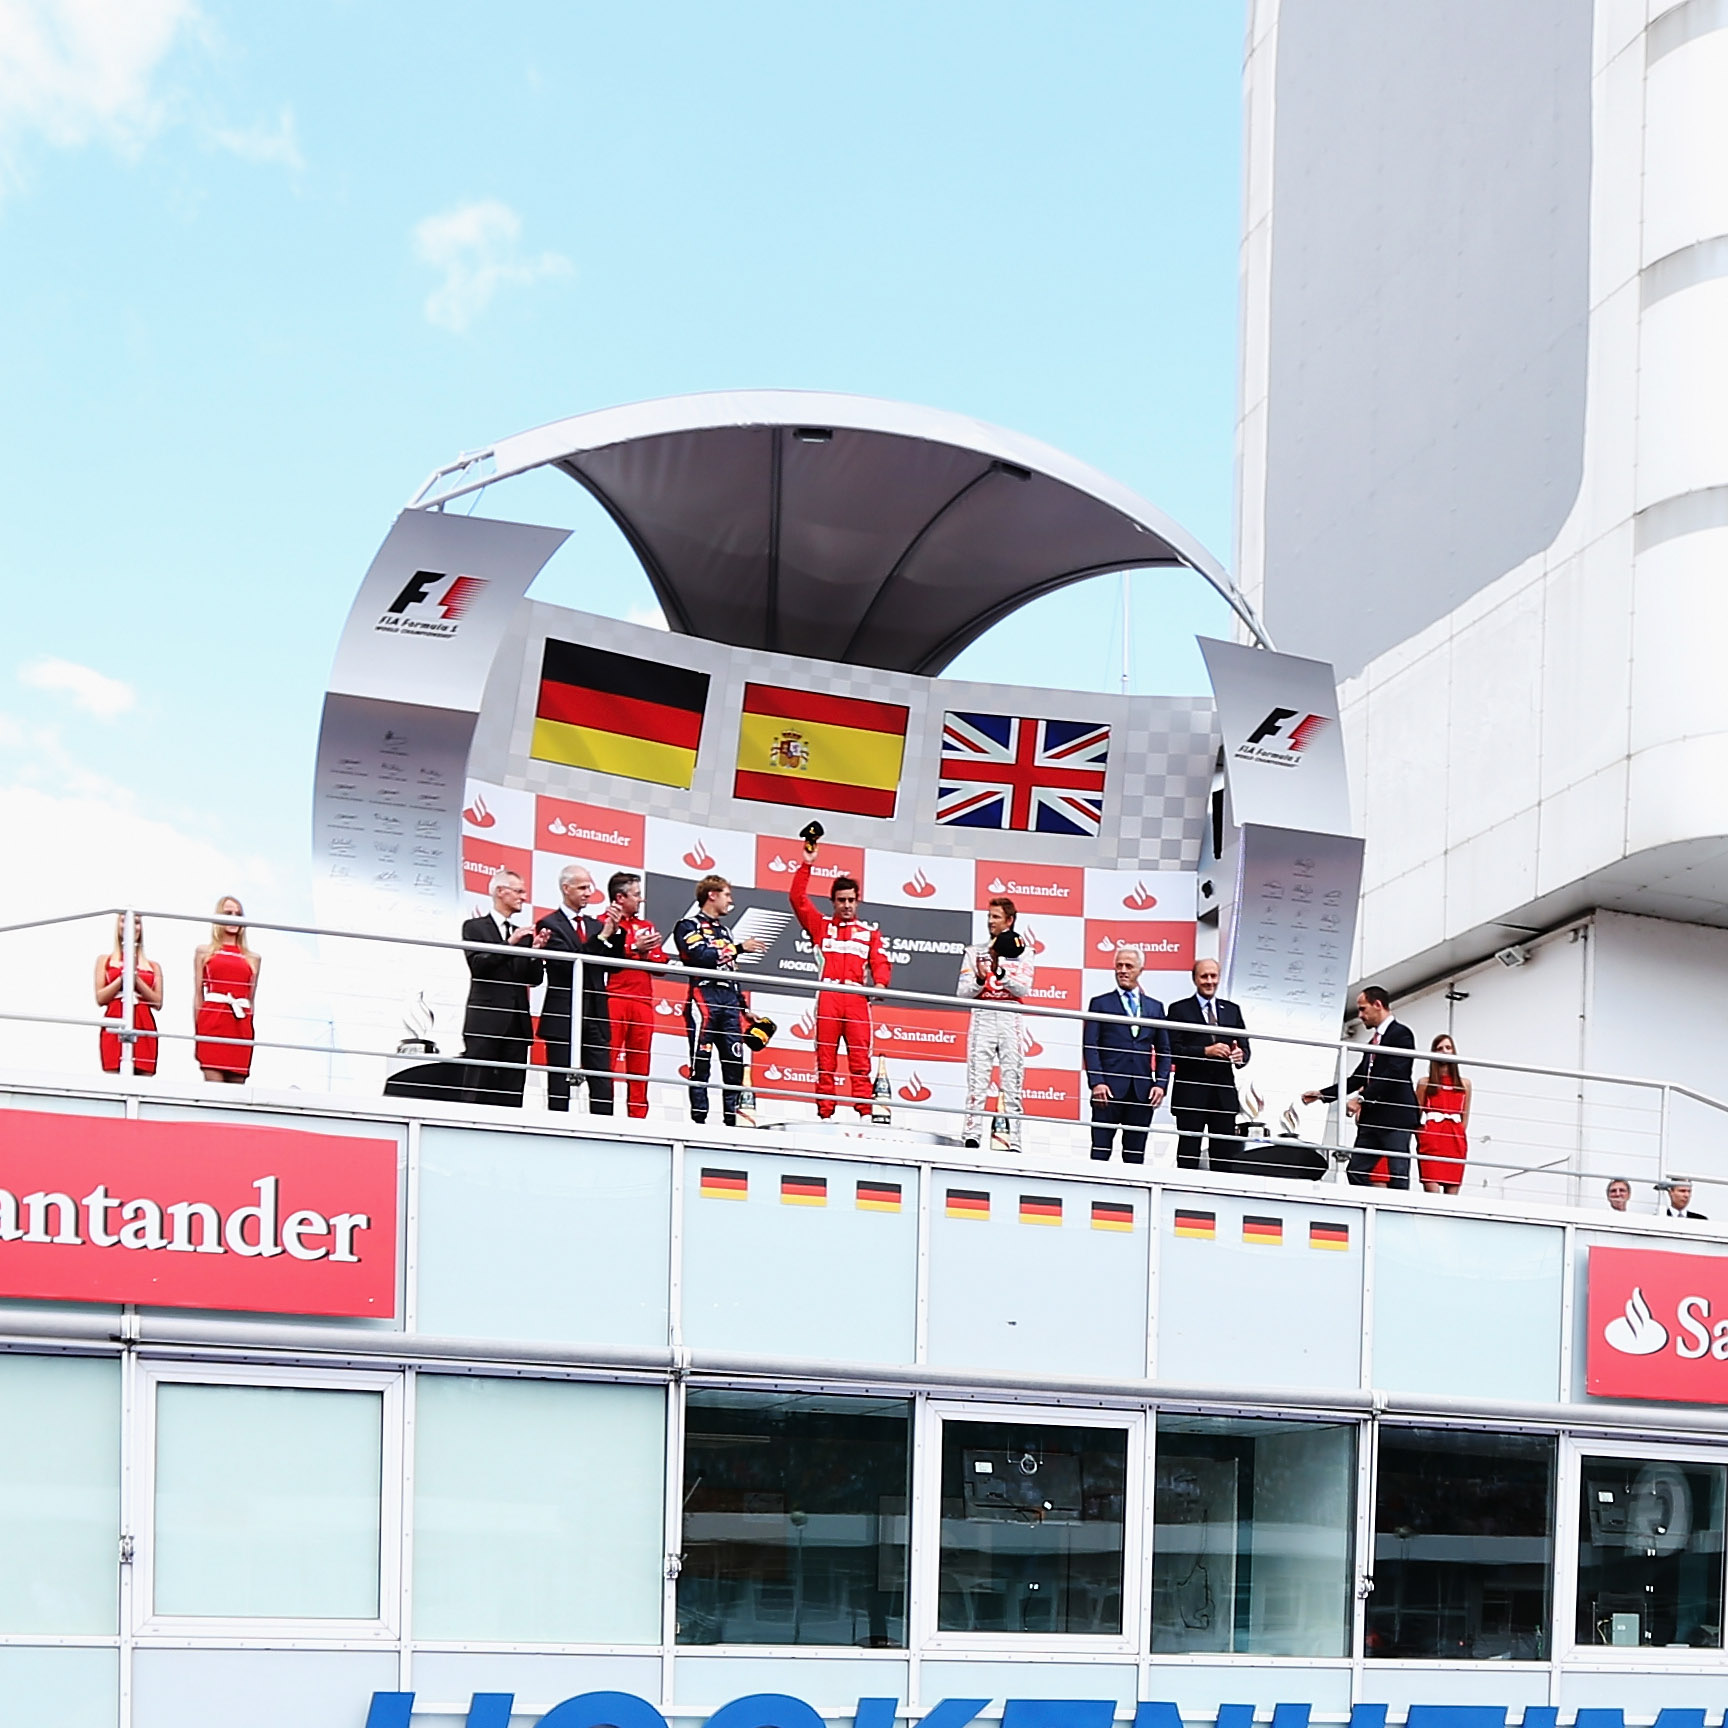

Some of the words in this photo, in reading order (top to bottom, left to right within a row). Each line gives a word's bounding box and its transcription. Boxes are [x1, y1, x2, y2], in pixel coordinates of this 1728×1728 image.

[387, 569, 491, 620] F1
[1246, 706, 1334, 753] F1
[567, 822, 631, 847] Santander
[1006, 880, 1071, 898] Santander
[892, 938, 965, 955] SANTANDER
[893, 1026, 957, 1044] Santander
